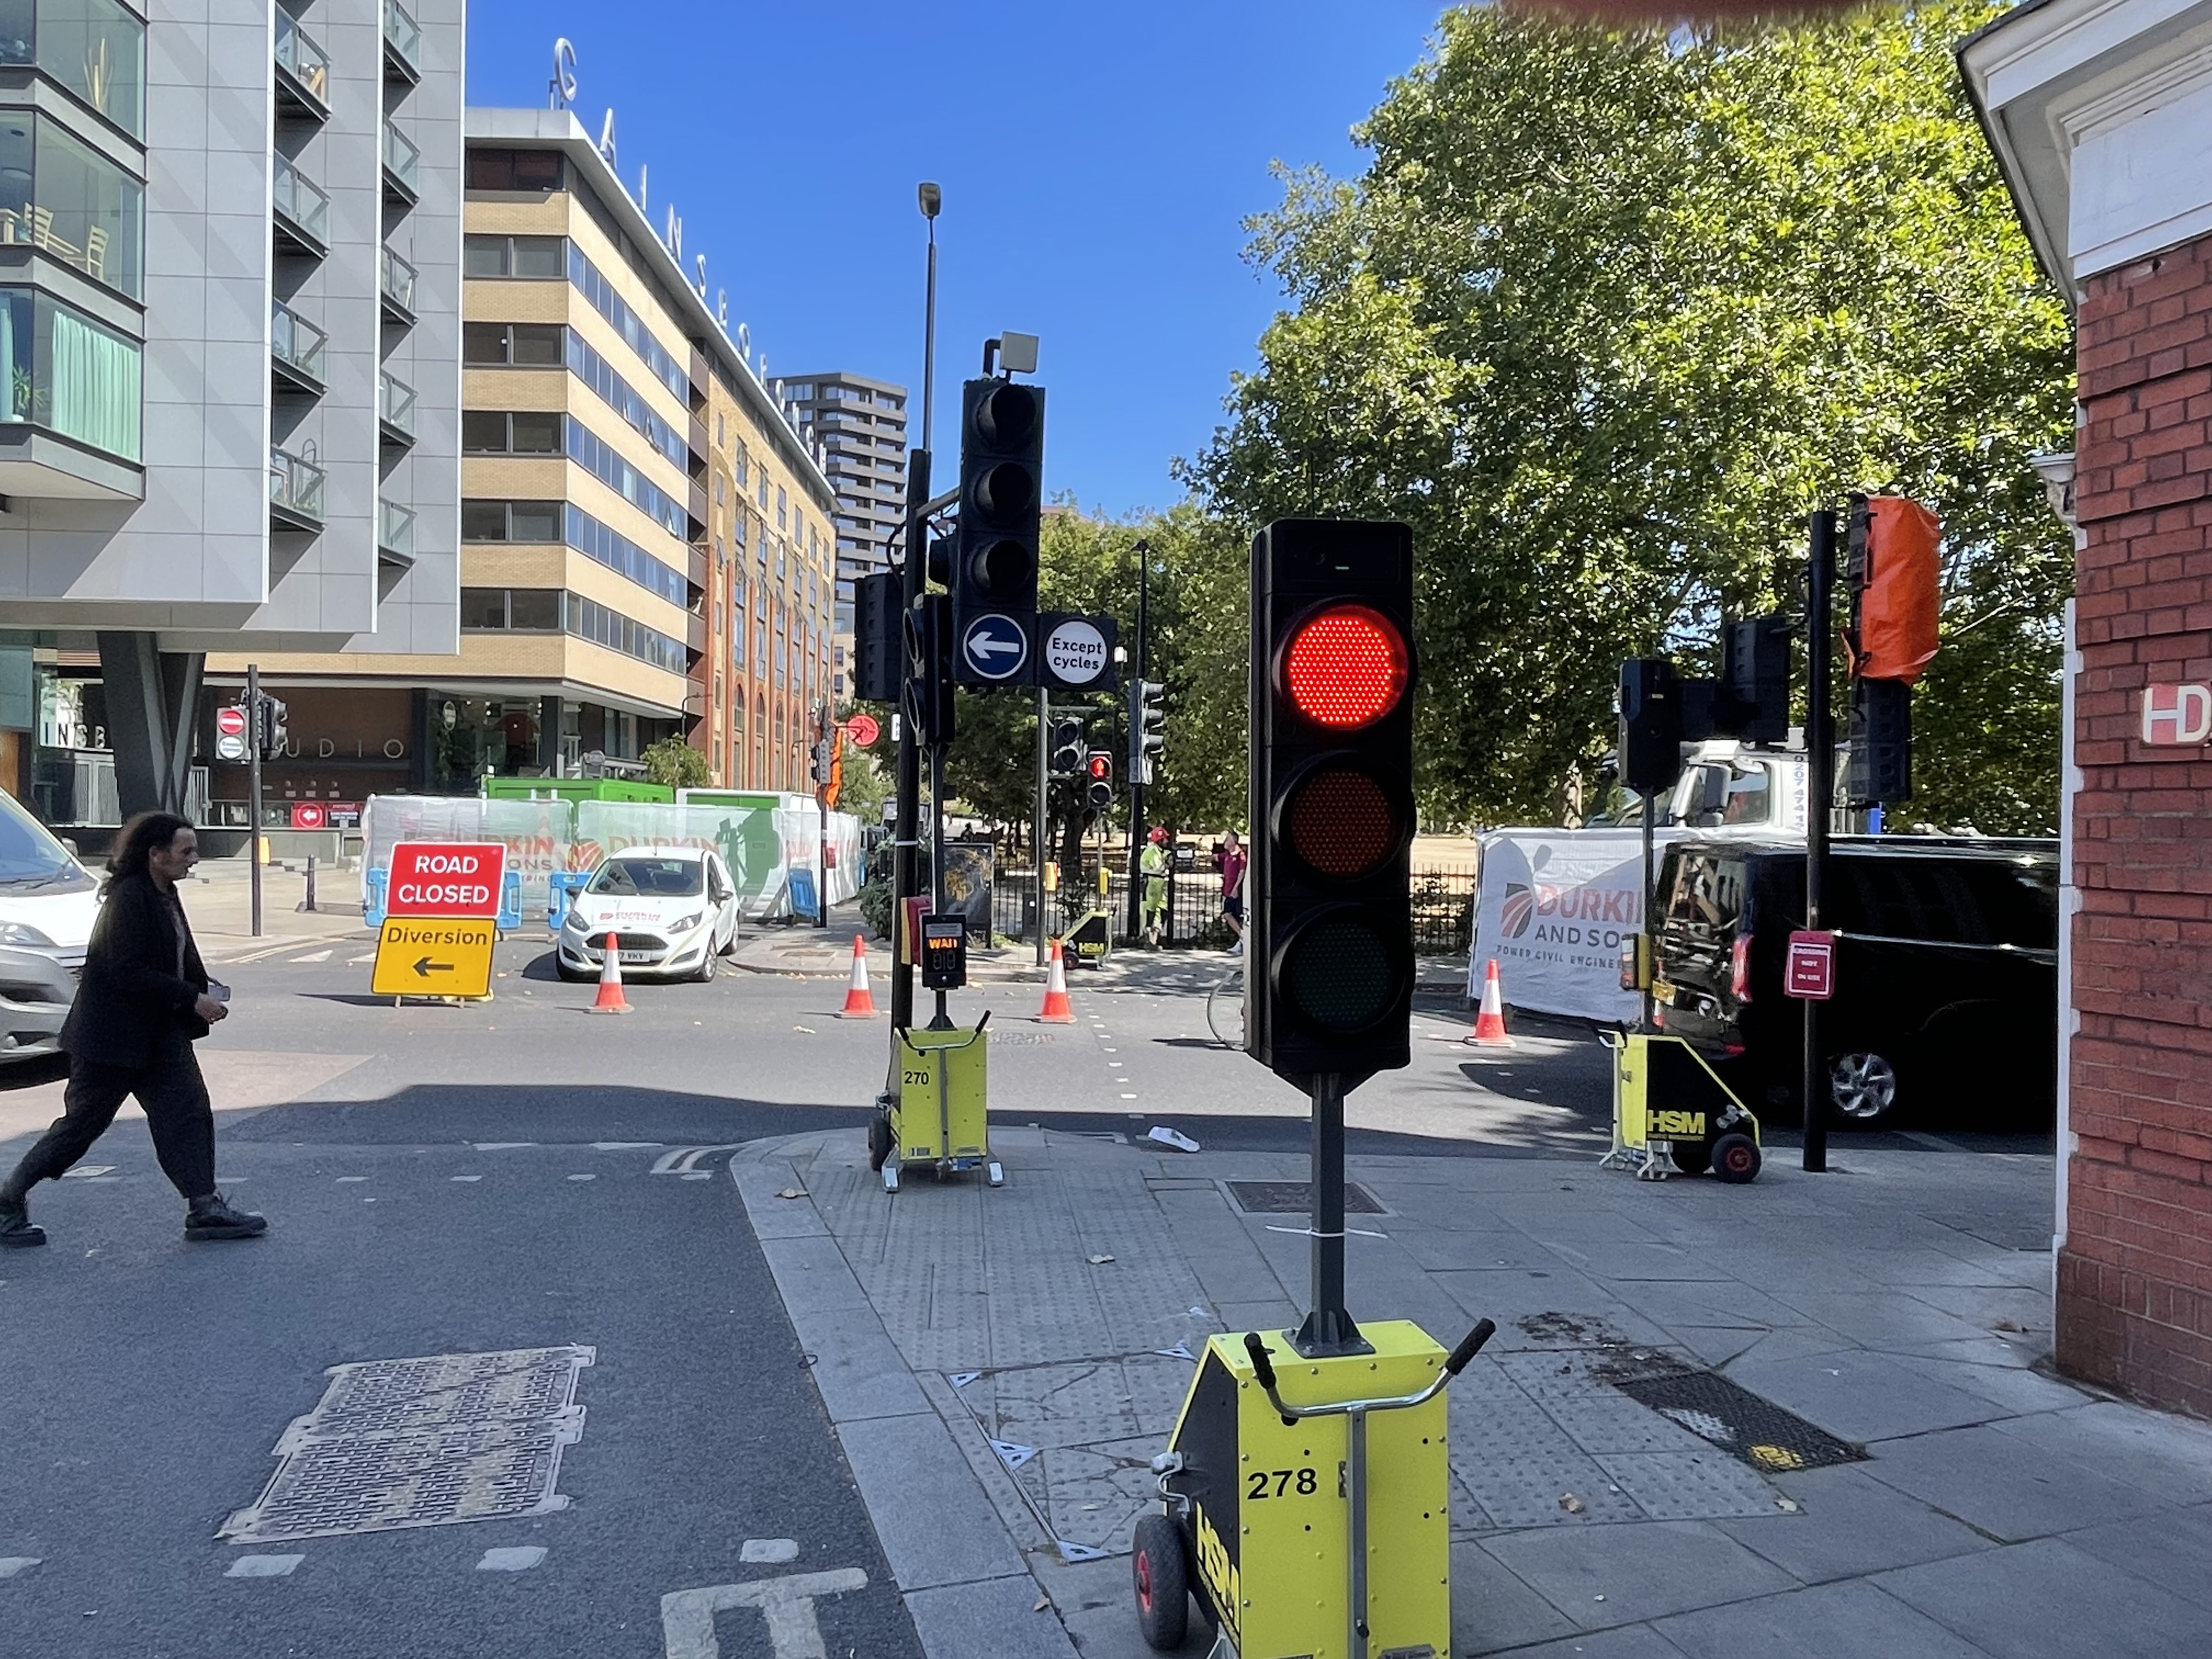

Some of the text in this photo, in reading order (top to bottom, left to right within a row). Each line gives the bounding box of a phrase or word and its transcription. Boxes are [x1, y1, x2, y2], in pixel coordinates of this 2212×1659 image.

[1053, 637, 1102, 654] Except
[1053, 657, 1099, 669] cycles
[286, 738, 404, 758] UDIO
[415, 856, 478, 873] ROAD
[508, 859, 553, 870] ONS
[398, 884, 489, 904] CLOSED
[387, 927, 487, 945] Diversion
[1535, 924, 1620, 948] AND SO
[1497, 945, 1621, 969] POWER CIVIL ENGINE
[905, 1071, 929, 1085] 270
[1646, 1109, 1705, 1135] HSM
[1247, 1468, 1317, 1500] 278
